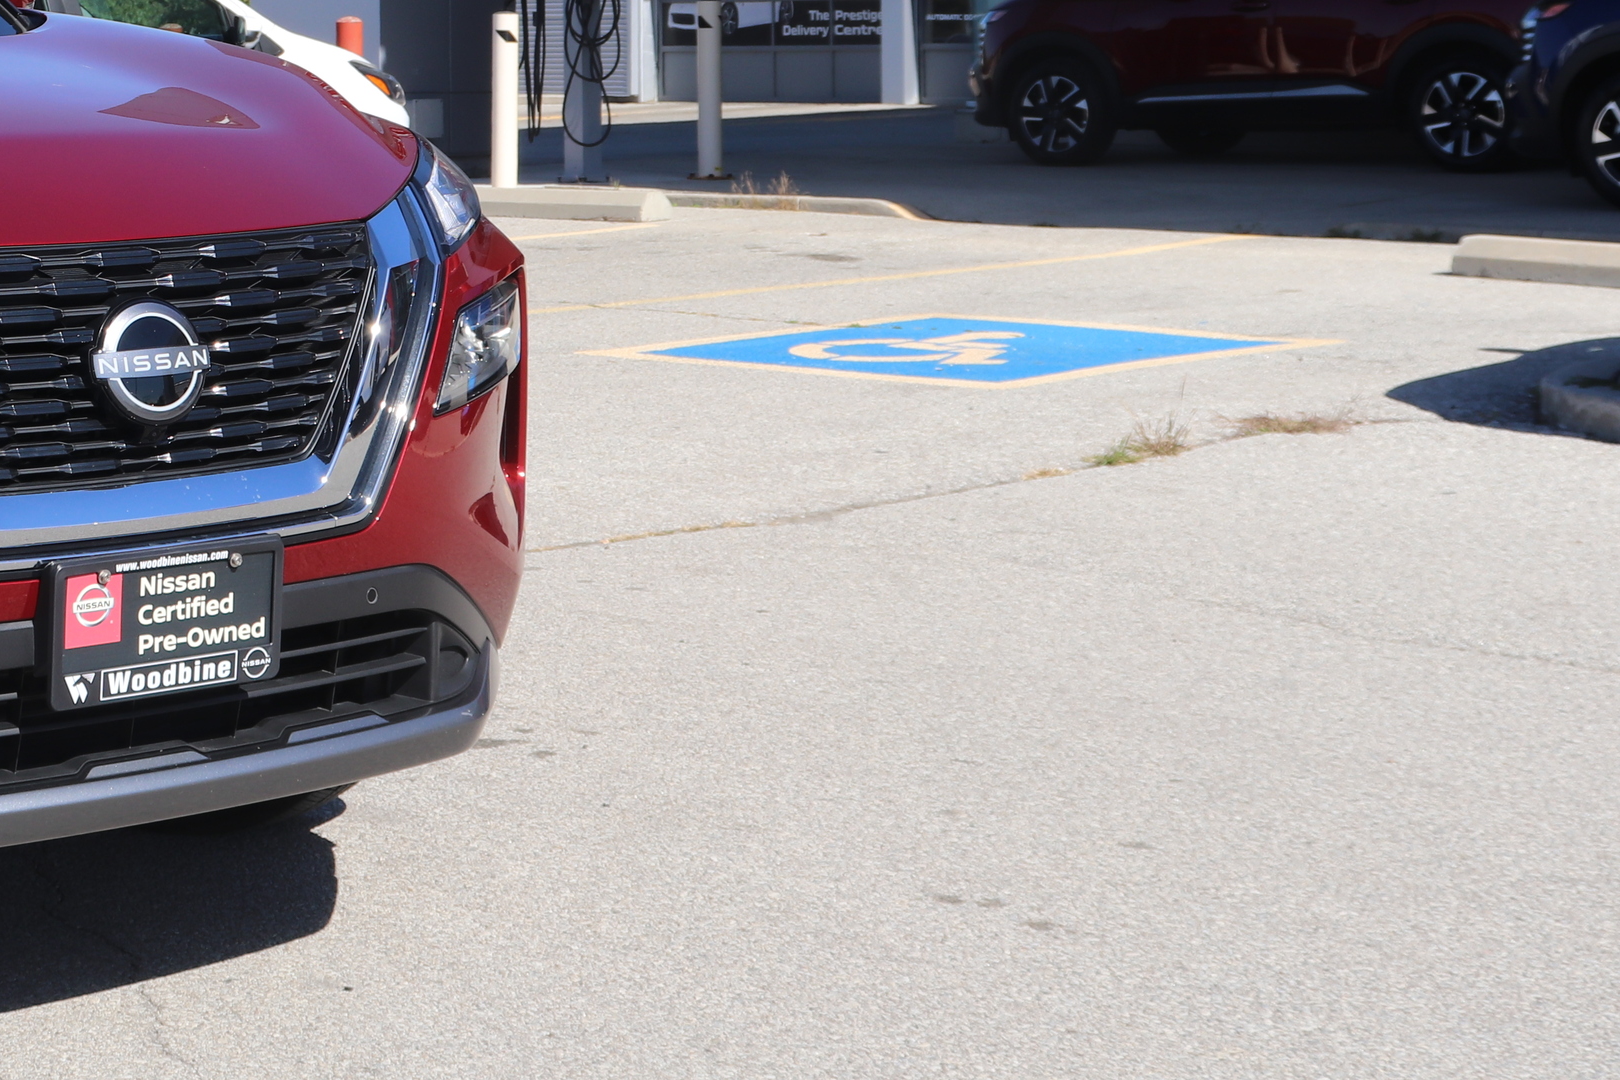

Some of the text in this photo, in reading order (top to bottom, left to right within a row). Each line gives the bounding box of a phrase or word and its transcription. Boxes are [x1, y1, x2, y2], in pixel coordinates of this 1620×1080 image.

[808, 9, 830, 21] The
[782, 24, 830, 38] Delivery
[97, 348, 209, 375] NISSAN
[115, 549, 229, 573] www.woodbinenissan.com
[139, 570, 216, 597] Nissan
[76, 600, 111, 611] NISSAN
[137, 591, 234, 625] Certified
[138, 616, 266, 656] Pre-Owned
[241, 657, 272, 668] NISSAN
[107, 659, 232, 695] Woodbine
